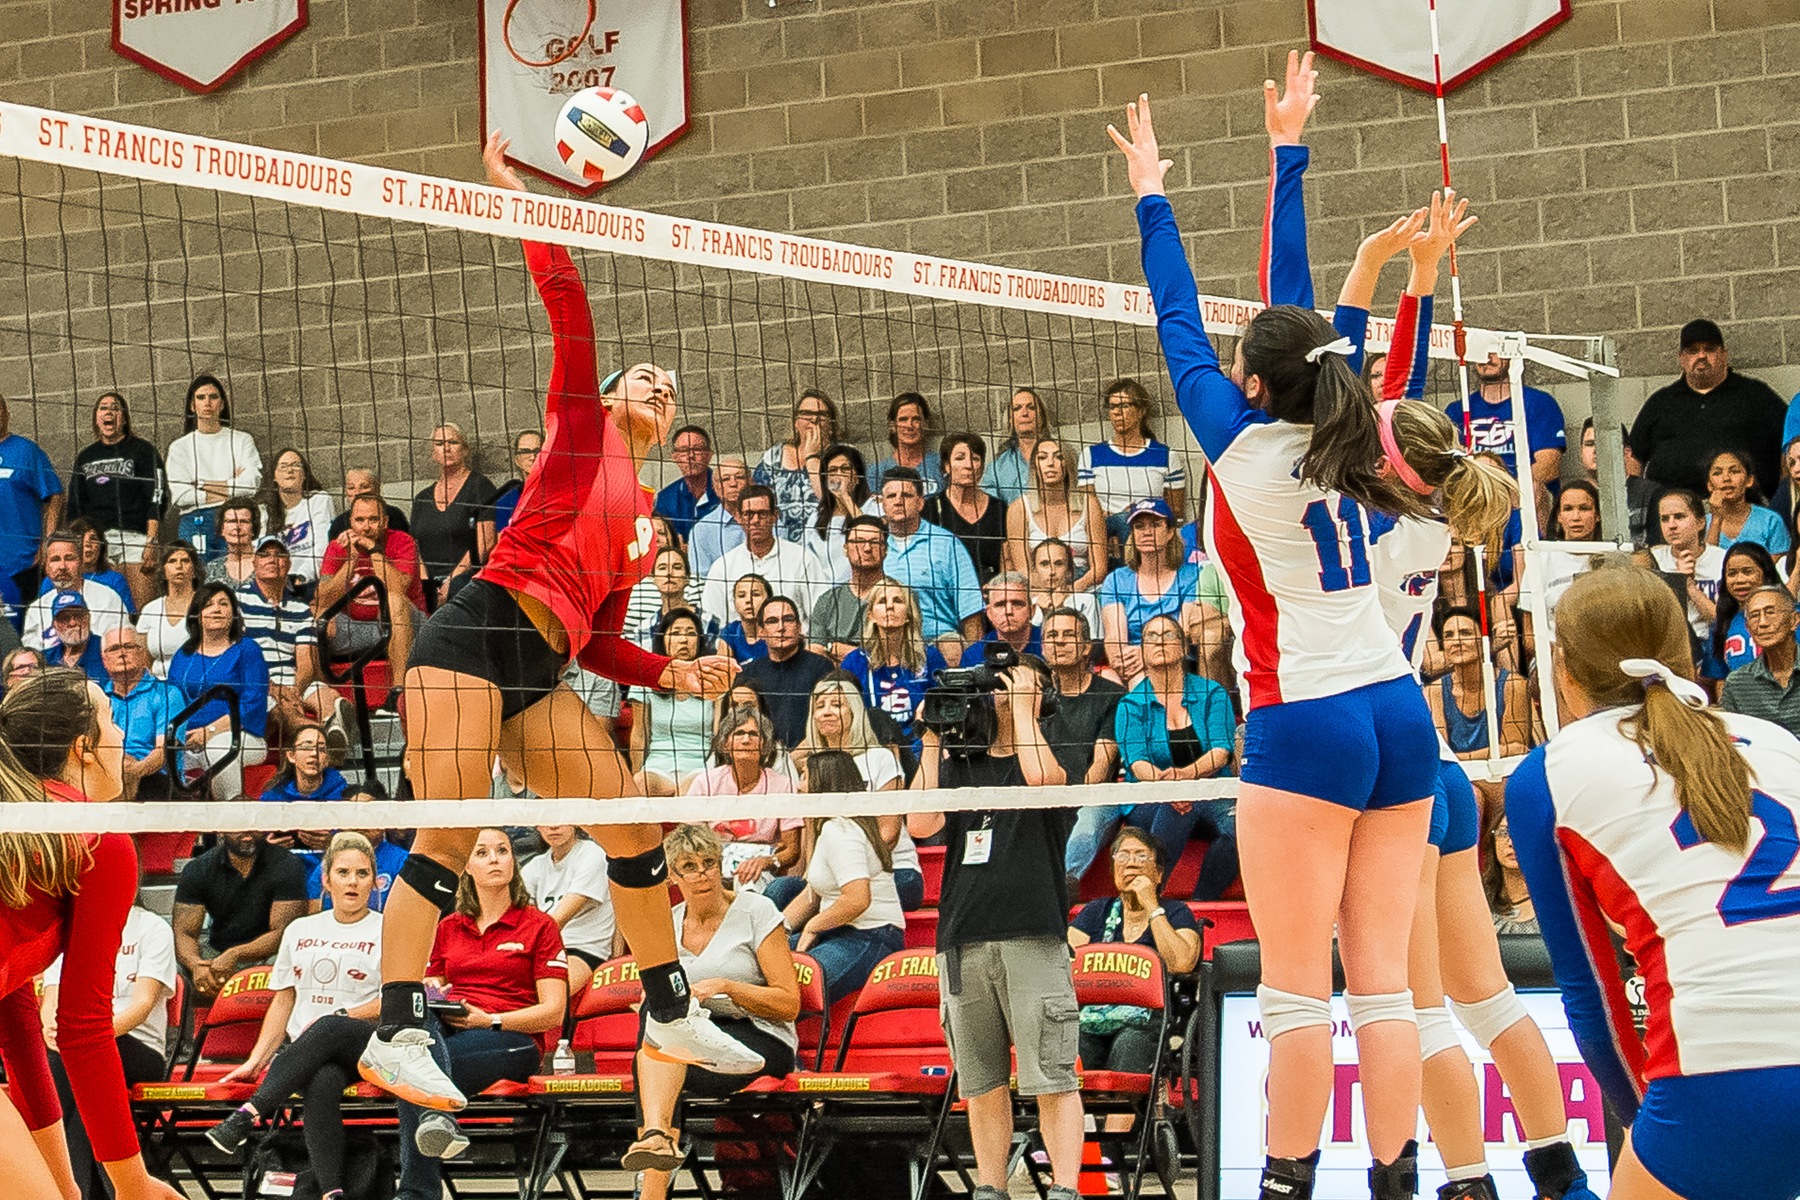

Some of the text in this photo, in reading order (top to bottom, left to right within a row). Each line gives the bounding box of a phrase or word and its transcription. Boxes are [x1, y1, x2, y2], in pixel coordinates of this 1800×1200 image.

[549, 66, 616, 94] 2007
[38, 117, 74, 150] ST.
[83, 125, 185, 170] FRANCIS
[193, 144, 353, 197] TROUBADOURS
[382, 177, 645, 242] ST. FRANCIS TROUBADOURS
[671, 223, 893, 279] ST. FRANCIS TROUBADOURS
[913, 261, 1105, 309] ST. FRANCIS TROUBADOURS
[1123, 290, 1143, 314] ST.
[1204, 301, 1262, 326] TROUBAD
[1300, 492, 1373, 593] 11
[1669, 788, 1800, 928] 2
[295, 938, 376, 955] HOLY COURT
[591, 966, 618, 990] ST.
[872, 956, 938, 984] ST. FRAN
[1082, 951, 1152, 979] FRANCIS
[222, 975, 245, 998] ST.
[544, 1078, 623, 1093] TROUBADOURS
